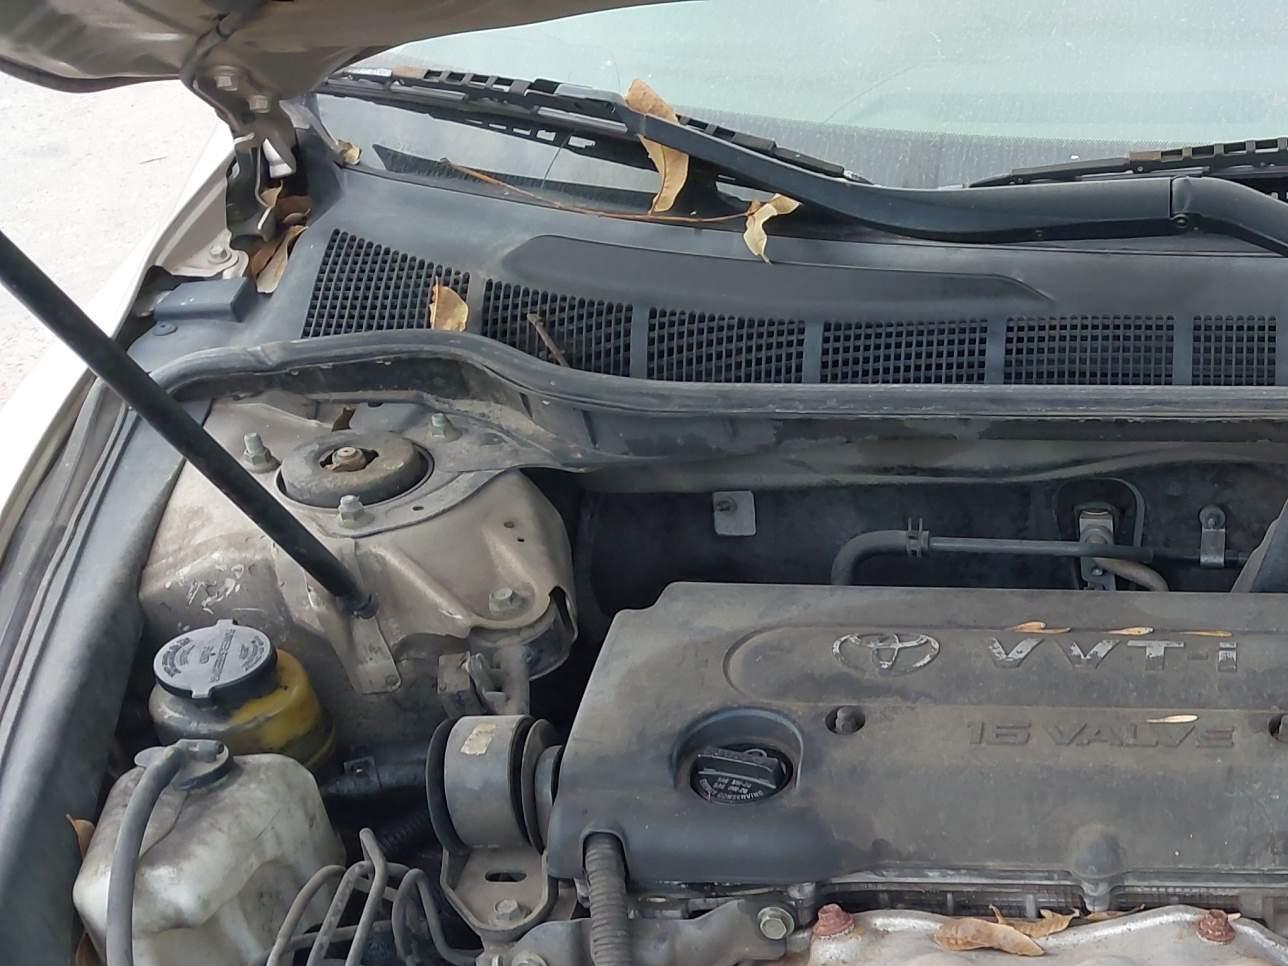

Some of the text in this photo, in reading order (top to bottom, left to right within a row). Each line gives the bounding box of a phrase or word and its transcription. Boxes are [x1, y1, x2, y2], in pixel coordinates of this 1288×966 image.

[987, 637, 1238, 672] VVT-i
[967, 721, 1236, 748] 16 VALVE
